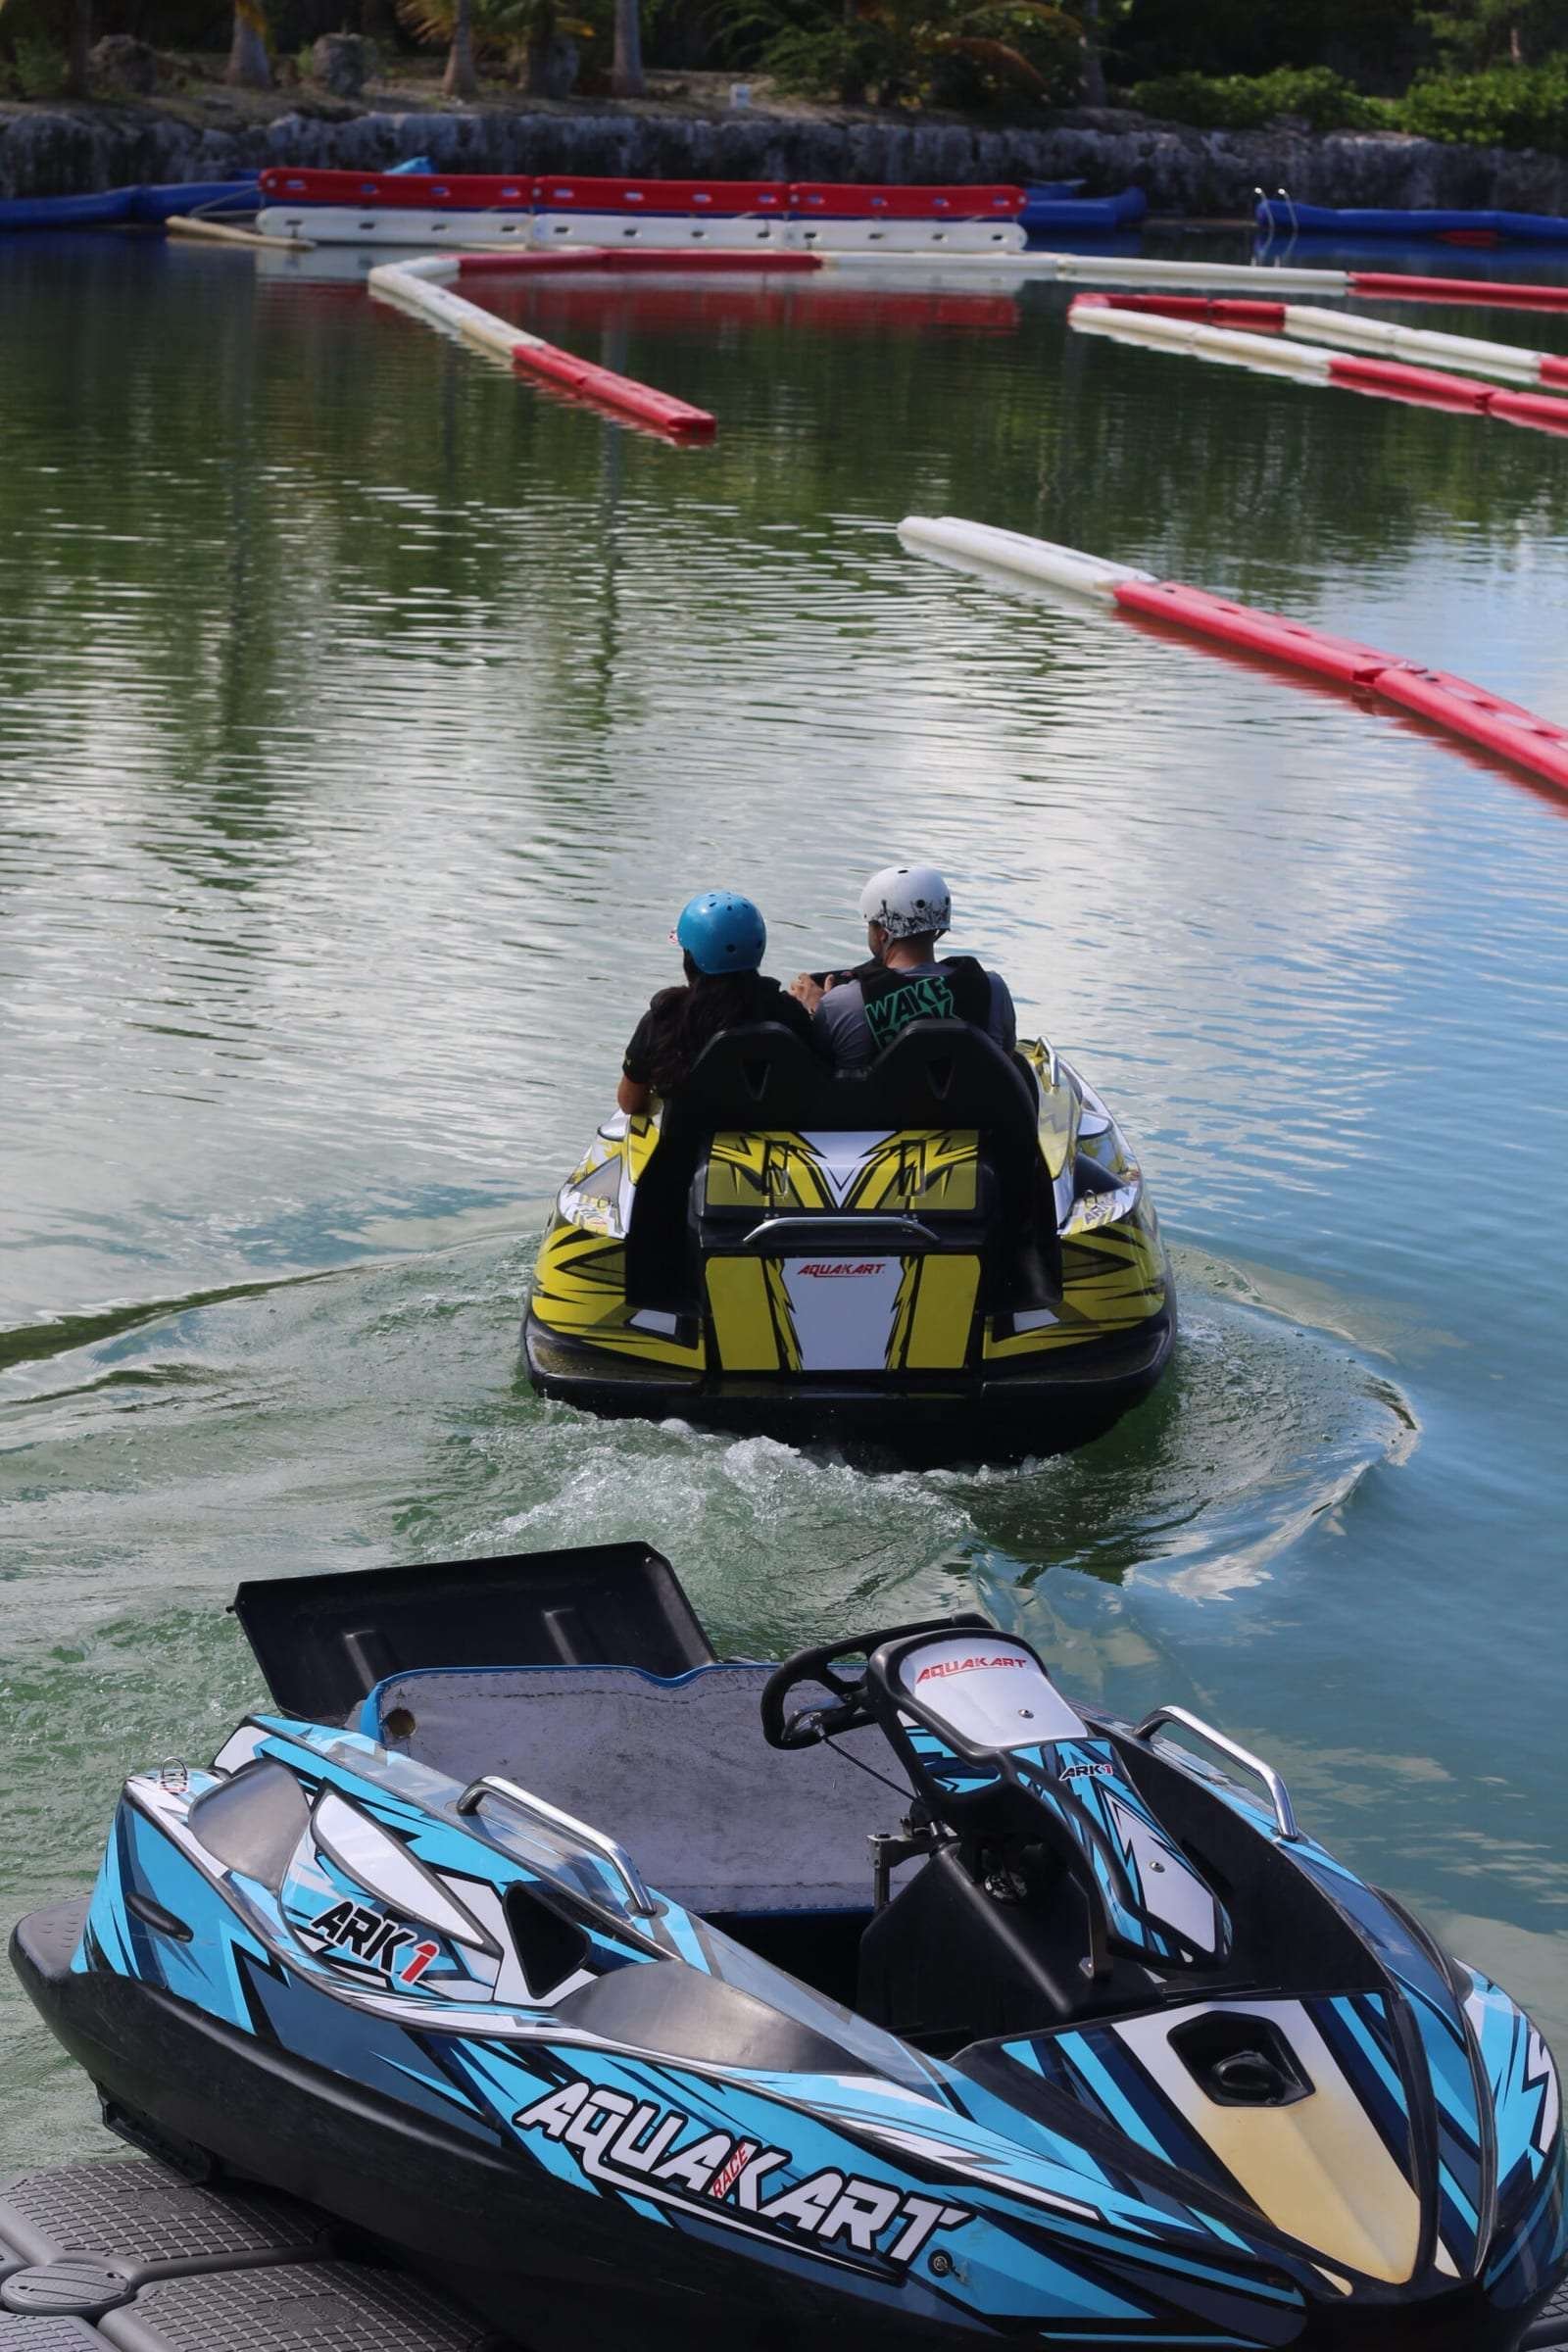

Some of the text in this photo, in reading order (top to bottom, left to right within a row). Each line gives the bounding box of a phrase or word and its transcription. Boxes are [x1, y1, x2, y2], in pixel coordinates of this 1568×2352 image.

[864, 974, 954, 1035] WAKE
[797, 1262, 886, 1278] AQUAKART
[915, 1657, 1027, 1685] AQUAKART
[513, 2080, 978, 2281] AQUAKART
[711, 2140, 749, 2197] RACE
